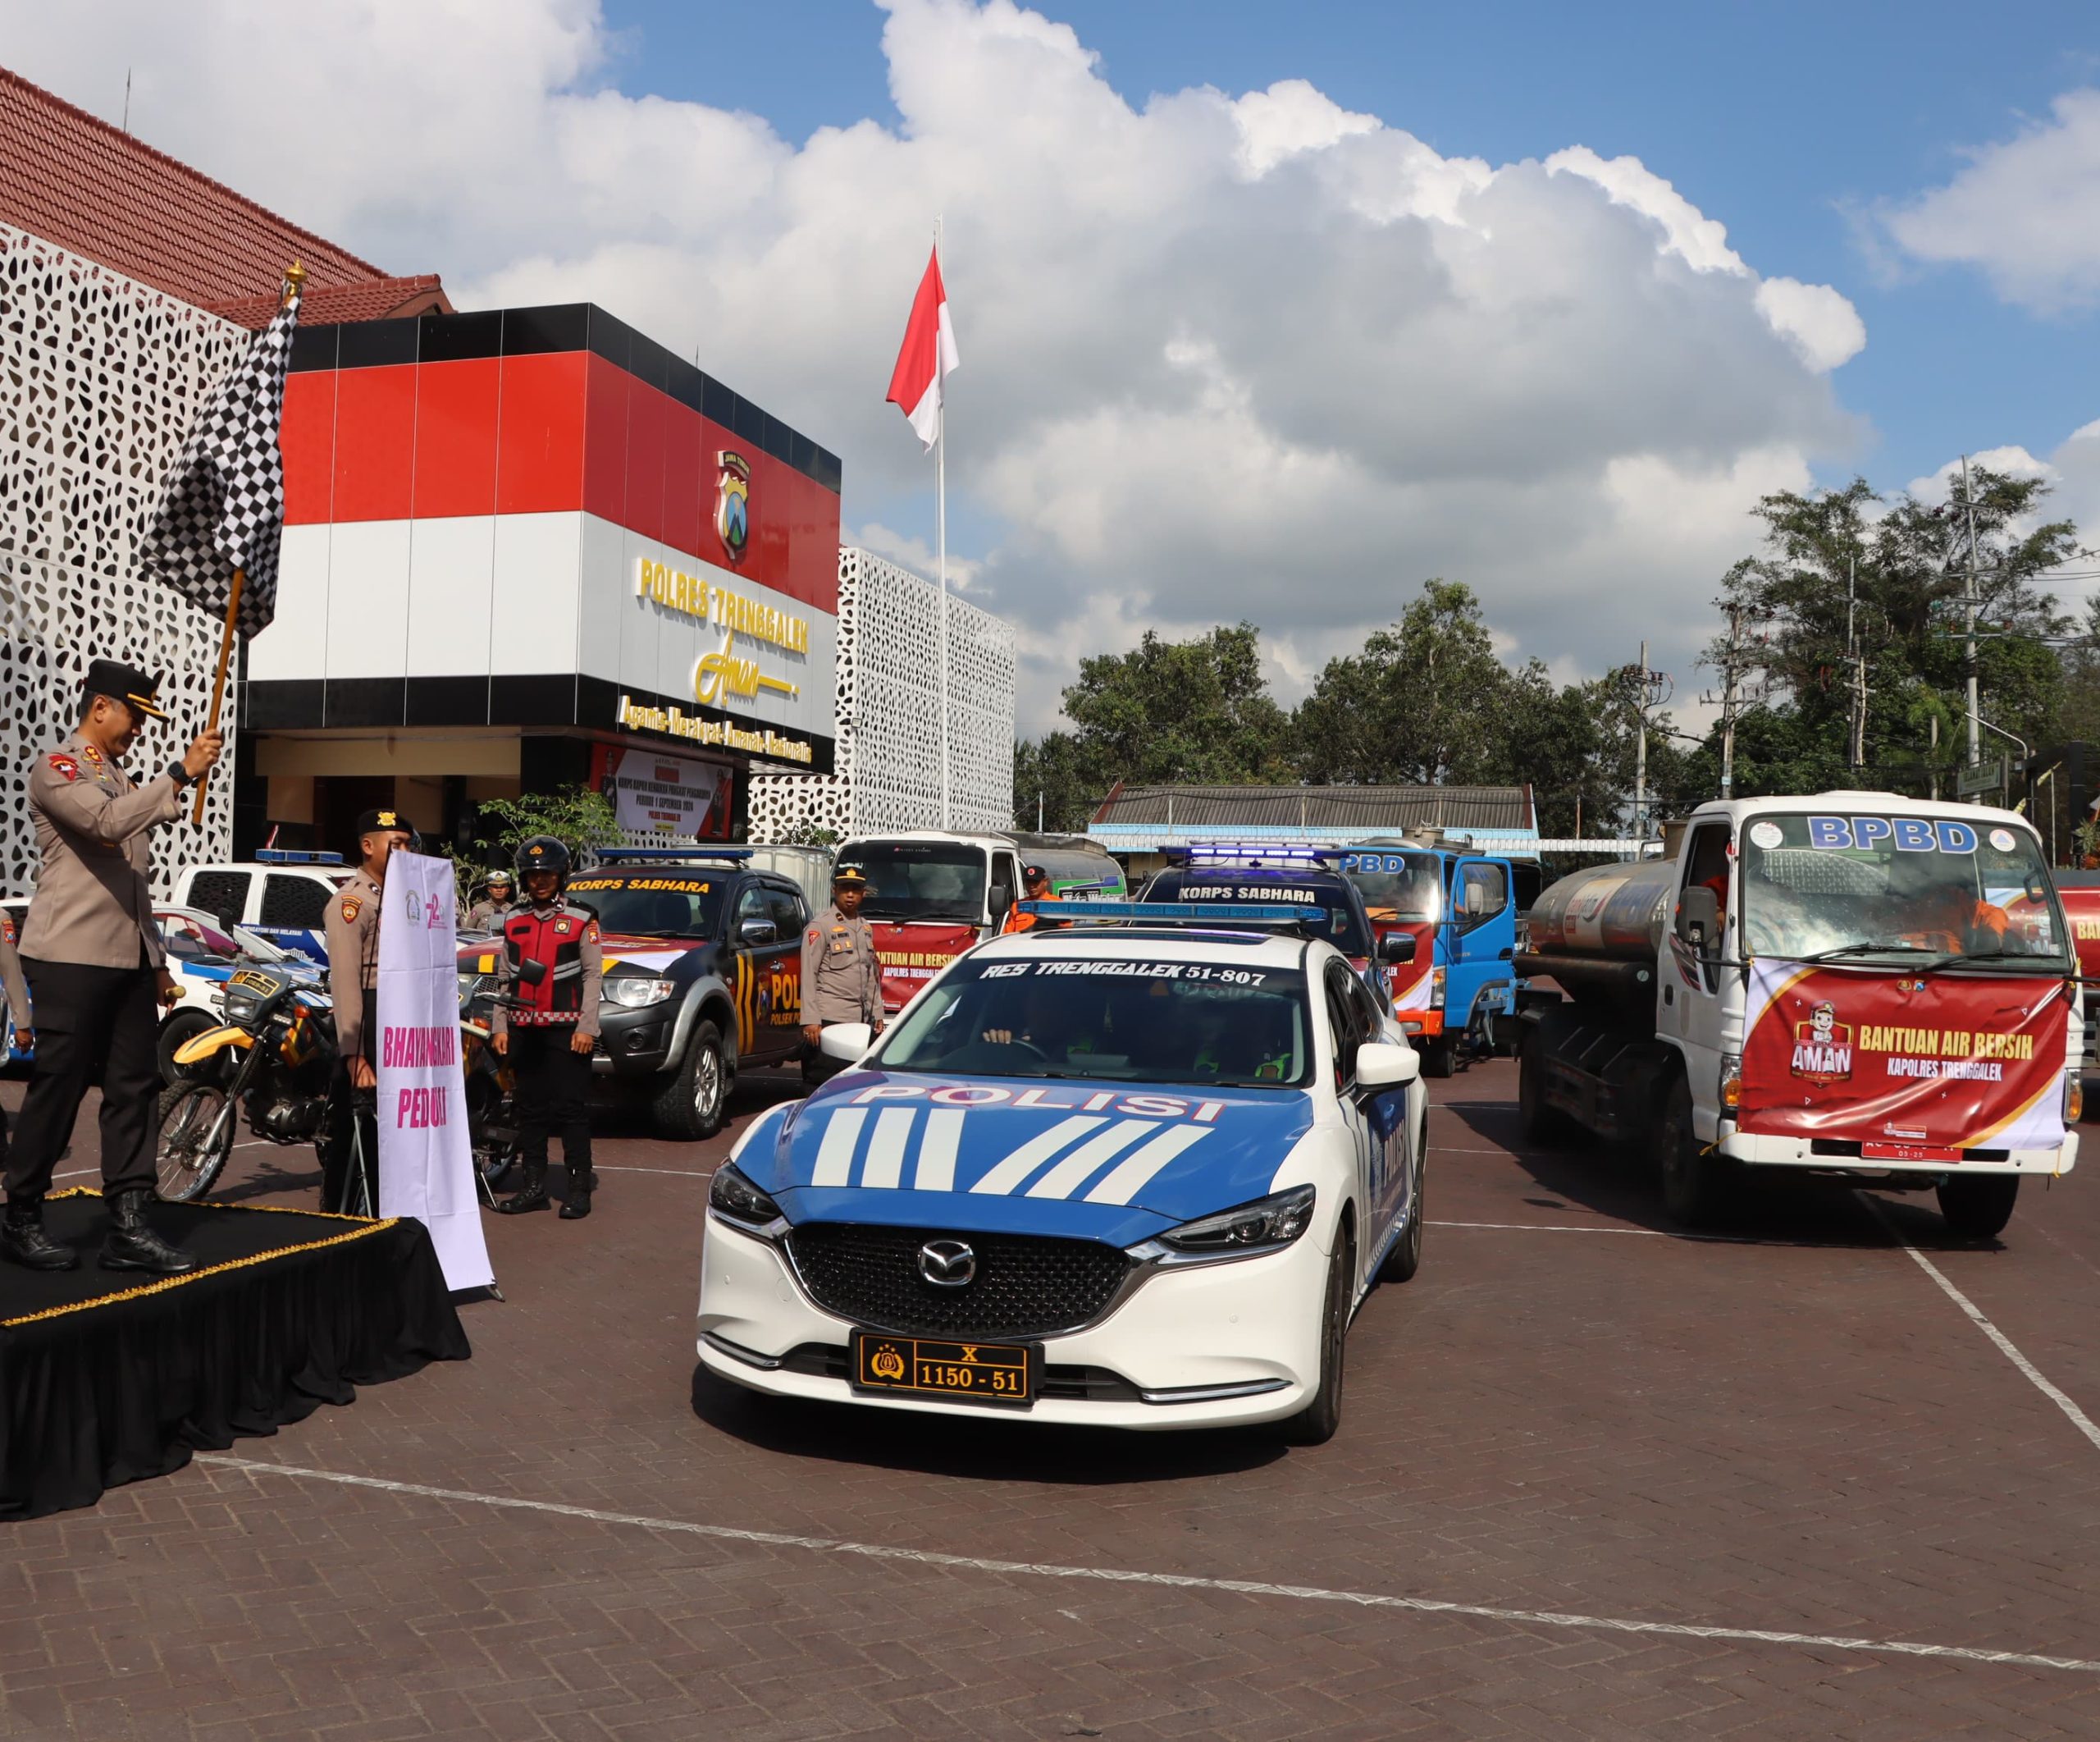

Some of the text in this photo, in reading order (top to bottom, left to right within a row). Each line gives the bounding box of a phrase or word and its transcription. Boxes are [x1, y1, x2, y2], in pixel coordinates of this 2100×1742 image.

[636, 557, 809, 654] POLRES TRENGGALEK
[1807, 816, 1979, 854] BPBD
[1339, 854, 1405, 875] PBD
[565, 879, 710, 894] KORPS SABHARA
[1178, 887, 1316, 903] KORPS SABHARA
[883, 967, 909, 977] KAPOLRES
[909, 953, 924, 967] AIR
[979, 962, 1267, 987] RES TRENGGALEK 51-807
[770, 1012, 792, 1026] POLSEK
[1859, 1025, 2034, 1060] BANTUAN AIR BERSIH
[1792, 1045, 1851, 1073] AMAN
[1887, 1057, 2002, 1081] KAPOLRES TRENGGALEK
[397, 1086, 447, 1129] PEDULI
[849, 1085, 1227, 1124] POLISI
[961, 1347, 978, 1362] X
[922, 1365, 972, 1388] 1150
[993, 1371, 1018, 1391] 51
